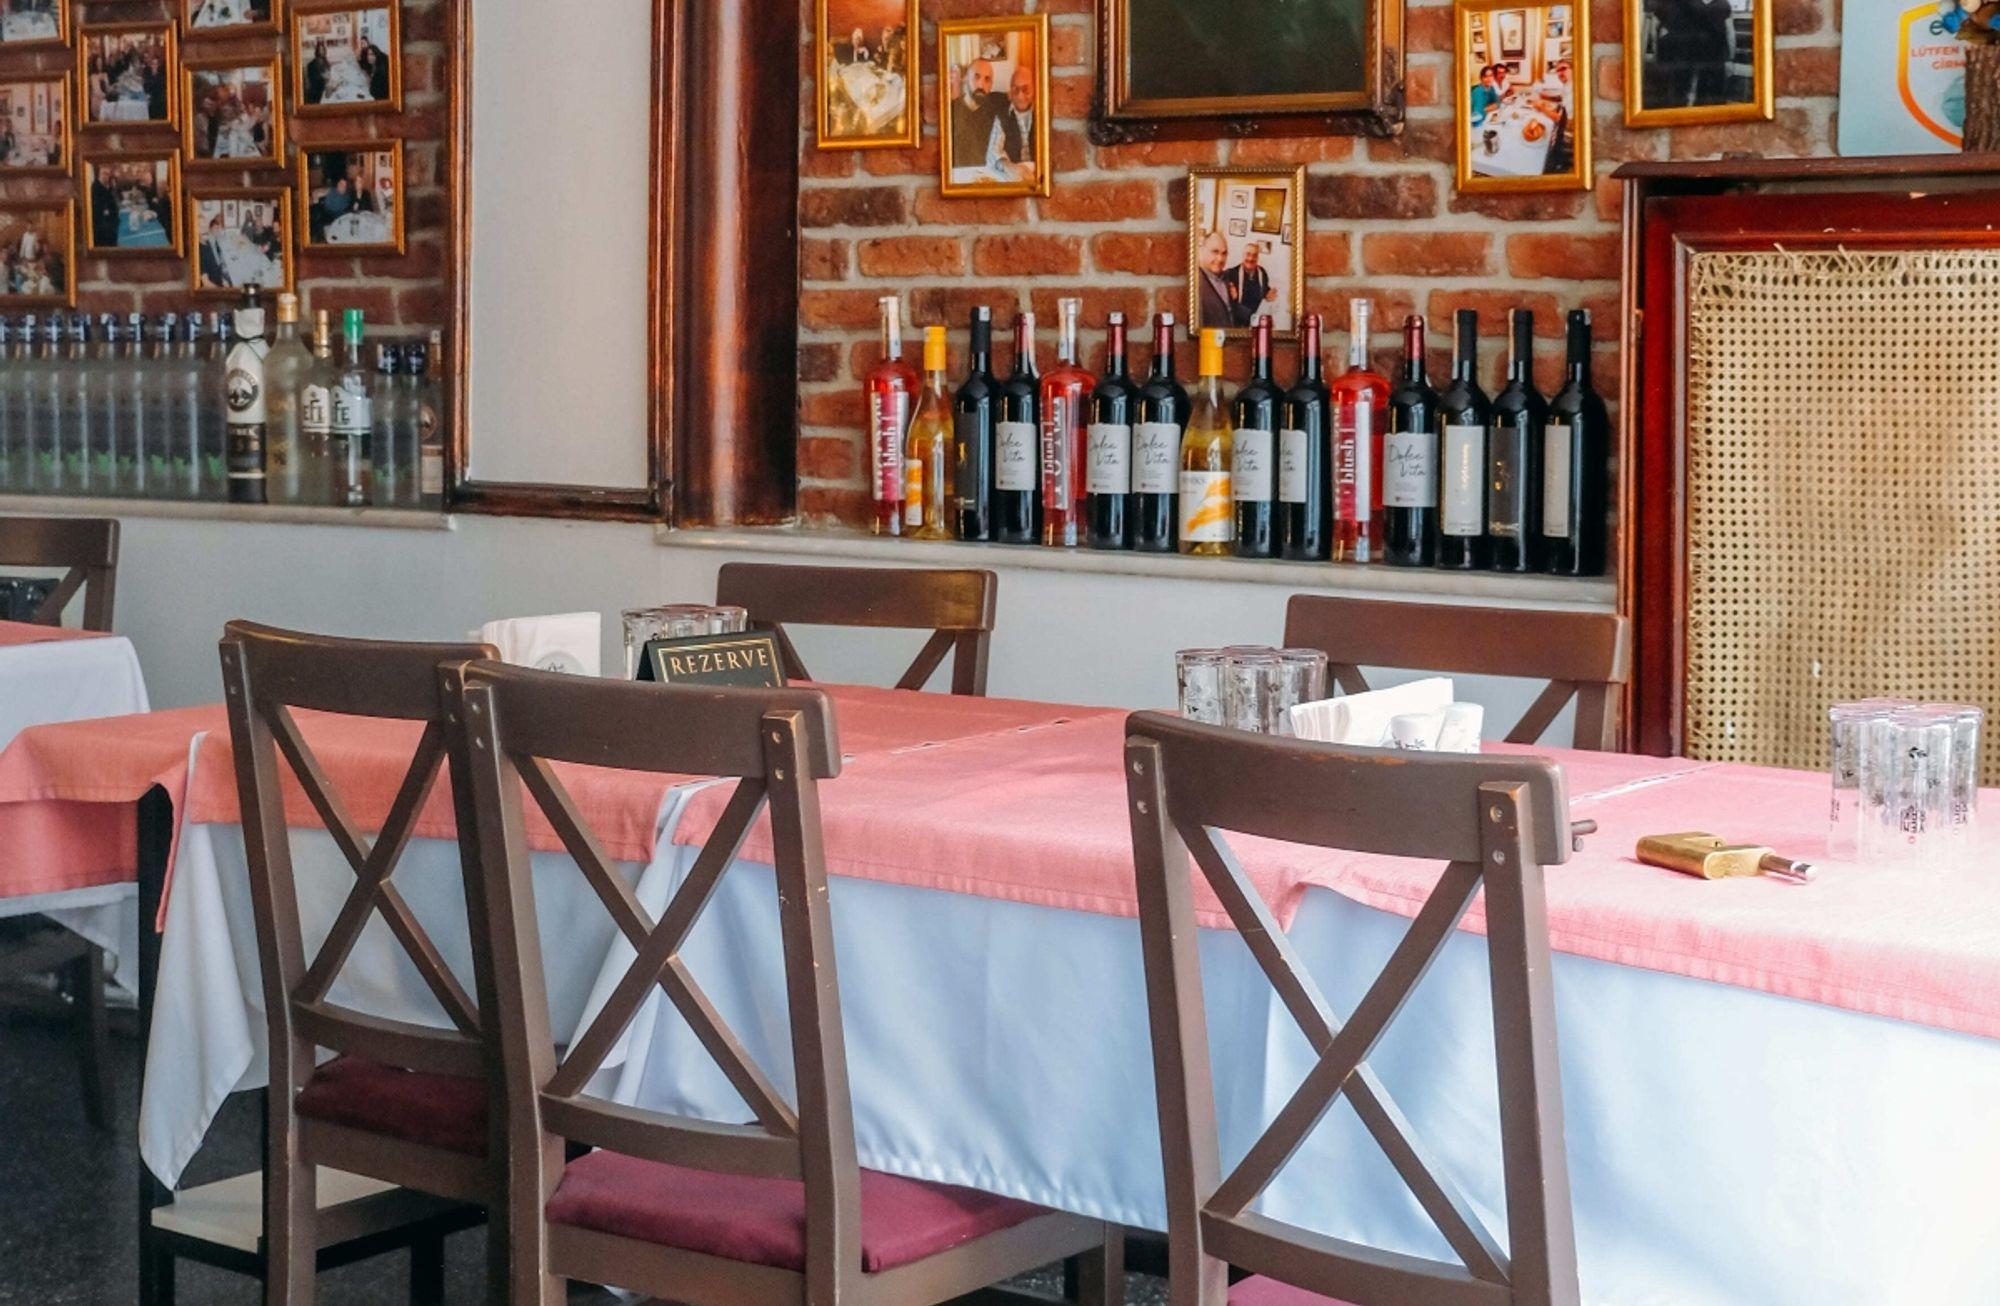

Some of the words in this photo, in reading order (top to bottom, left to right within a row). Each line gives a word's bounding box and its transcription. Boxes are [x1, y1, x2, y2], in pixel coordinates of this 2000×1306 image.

[1911, 45, 1959, 57] LÜTFEN
[882, 426, 897, 467] blush
[1043, 431, 1054, 474] blush
[1388, 444, 1424, 463] Dolce
[1340, 438, 1355, 485] blush
[1401, 461, 1426, 477] Vita
[670, 647, 769, 674] REZERVE
